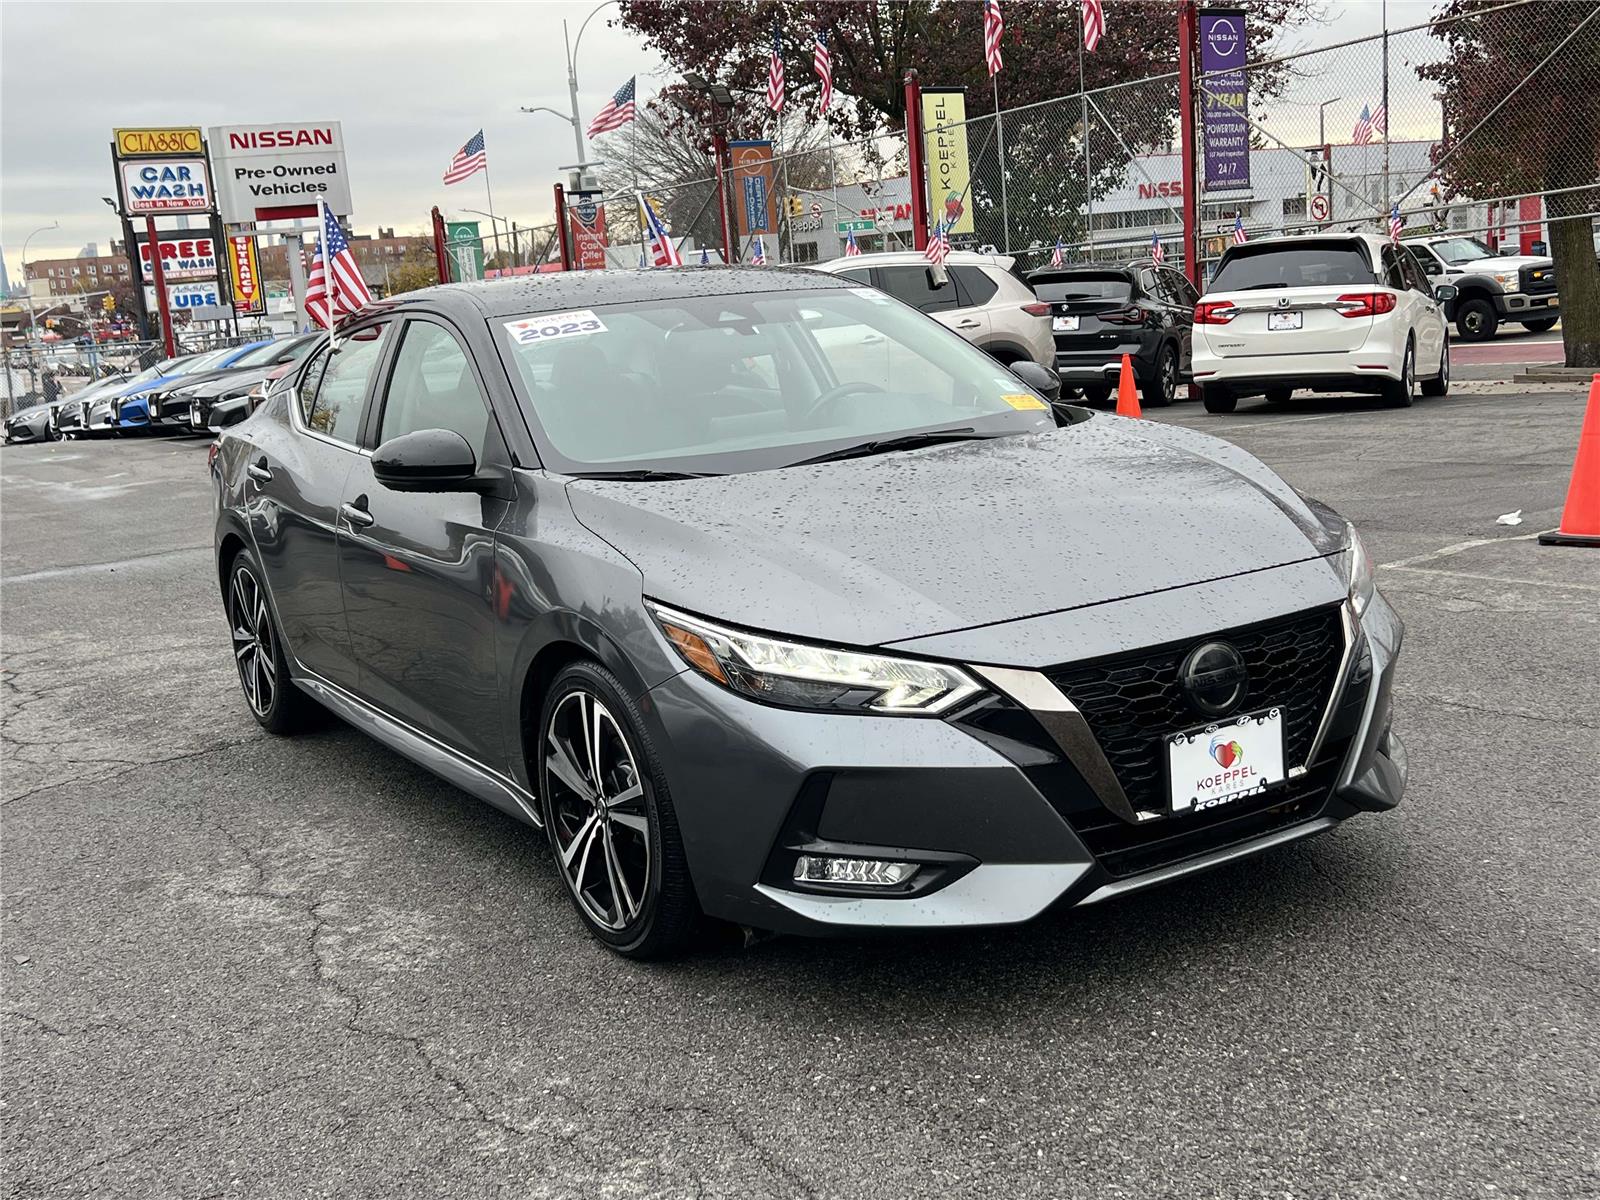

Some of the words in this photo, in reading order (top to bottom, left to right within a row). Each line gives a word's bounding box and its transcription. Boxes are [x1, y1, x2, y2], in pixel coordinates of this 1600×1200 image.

[1206, 123, 1246, 134] POWERTRAIN
[123, 132, 199, 152] CLASSIC
[229, 128, 333, 149] NISSAN
[935, 97, 951, 190] KOEPPEL
[946, 118, 957, 169] KARES
[1209, 136, 1245, 147] WARRANTY
[140, 166, 191, 183] CAR
[234, 163, 337, 179] Pre-Owned
[1218, 163, 1237, 175] 24/7
[130, 183, 204, 199] WASH
[249, 182, 328, 196] Vehicles
[1138, 181, 1184, 199] NISS
[790, 220, 823, 232] oeppel
[144, 261, 171, 272] CR
[178, 258, 214, 269] WASH
[235, 236, 253, 294] ENTRANCE
[150, 284, 214, 296] CASSIC
[174, 293, 216, 307] UBE
[519, 320, 601, 341] 2023
[1196, 765, 1257, 791] KOEPPEL
[1211, 781, 1245, 795] KARES
[1194, 786, 1267, 812] KOEPPEL
